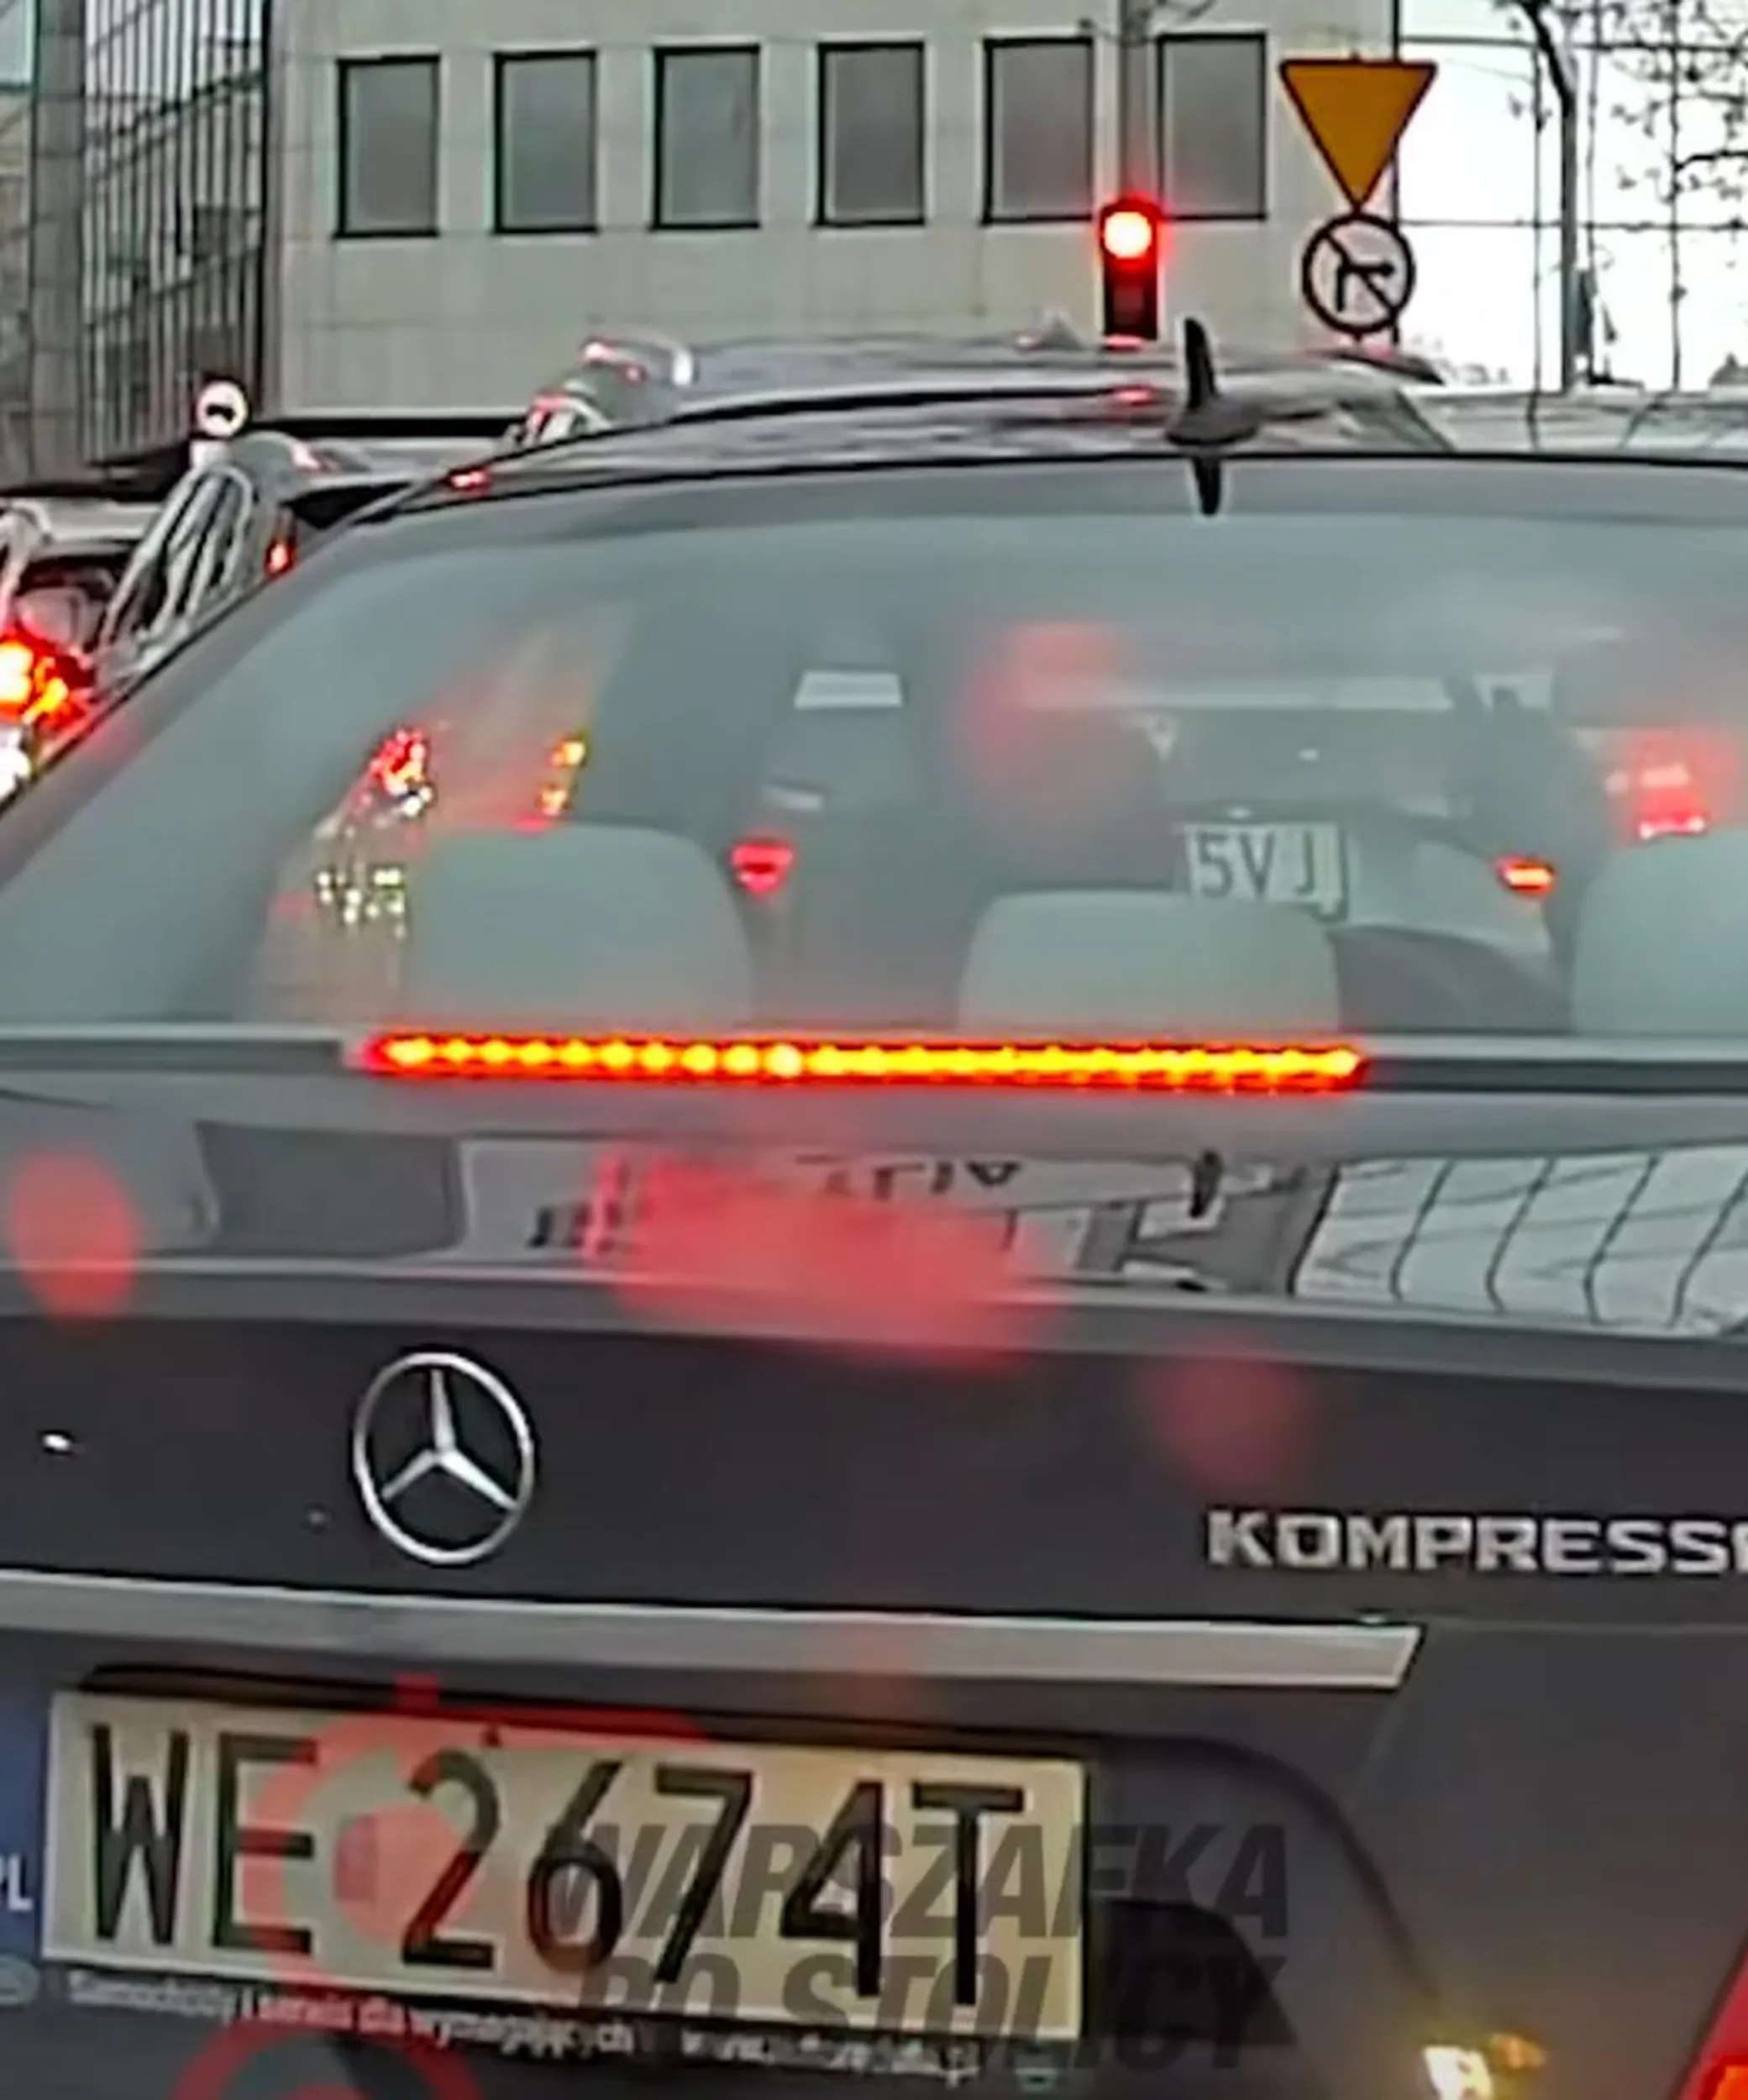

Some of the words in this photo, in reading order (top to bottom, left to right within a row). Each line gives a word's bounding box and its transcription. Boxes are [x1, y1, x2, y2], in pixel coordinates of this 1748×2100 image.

[1205, 1510, 1748, 1573] KOMPRESS
[0, 1855, 34, 1912] L
[92, 1723, 318, 1955] WE
[402, 1750, 1025, 2007] 2674T
